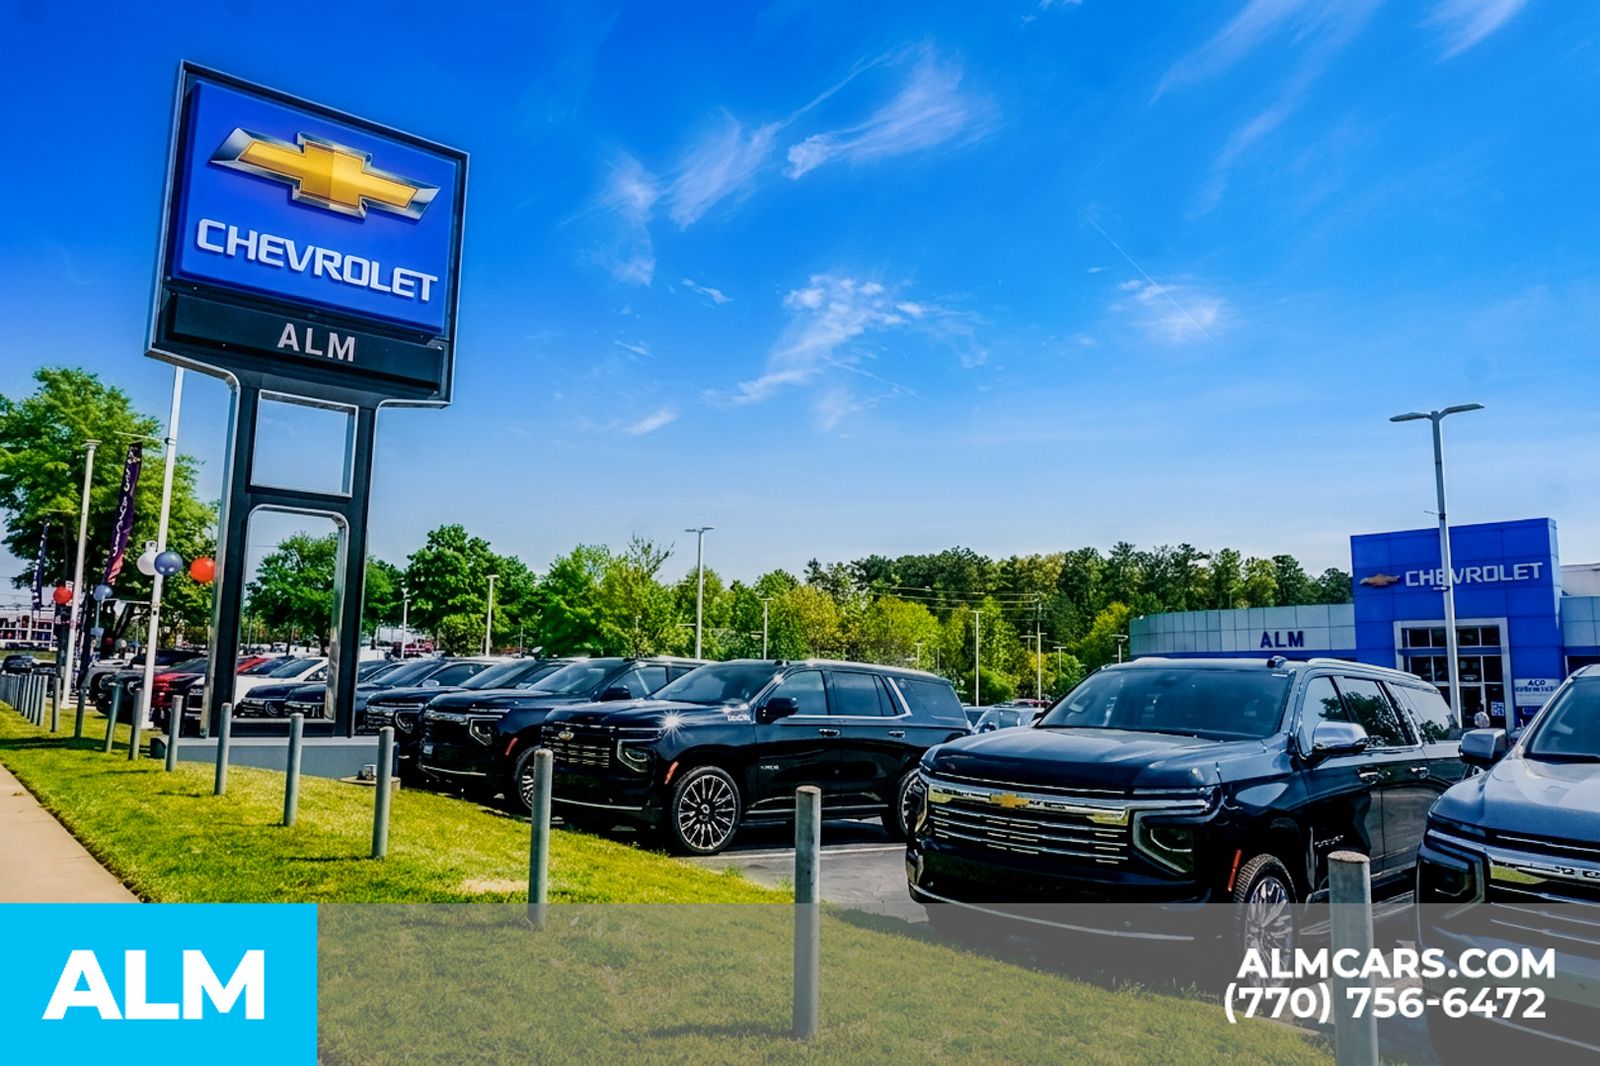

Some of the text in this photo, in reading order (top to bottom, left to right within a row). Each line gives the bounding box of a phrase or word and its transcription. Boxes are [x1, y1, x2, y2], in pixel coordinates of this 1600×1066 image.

[196, 217, 438, 302] CHEVROLET
[277, 322, 356, 362] ALM
[1260, 630, 1304, 648] ALM
